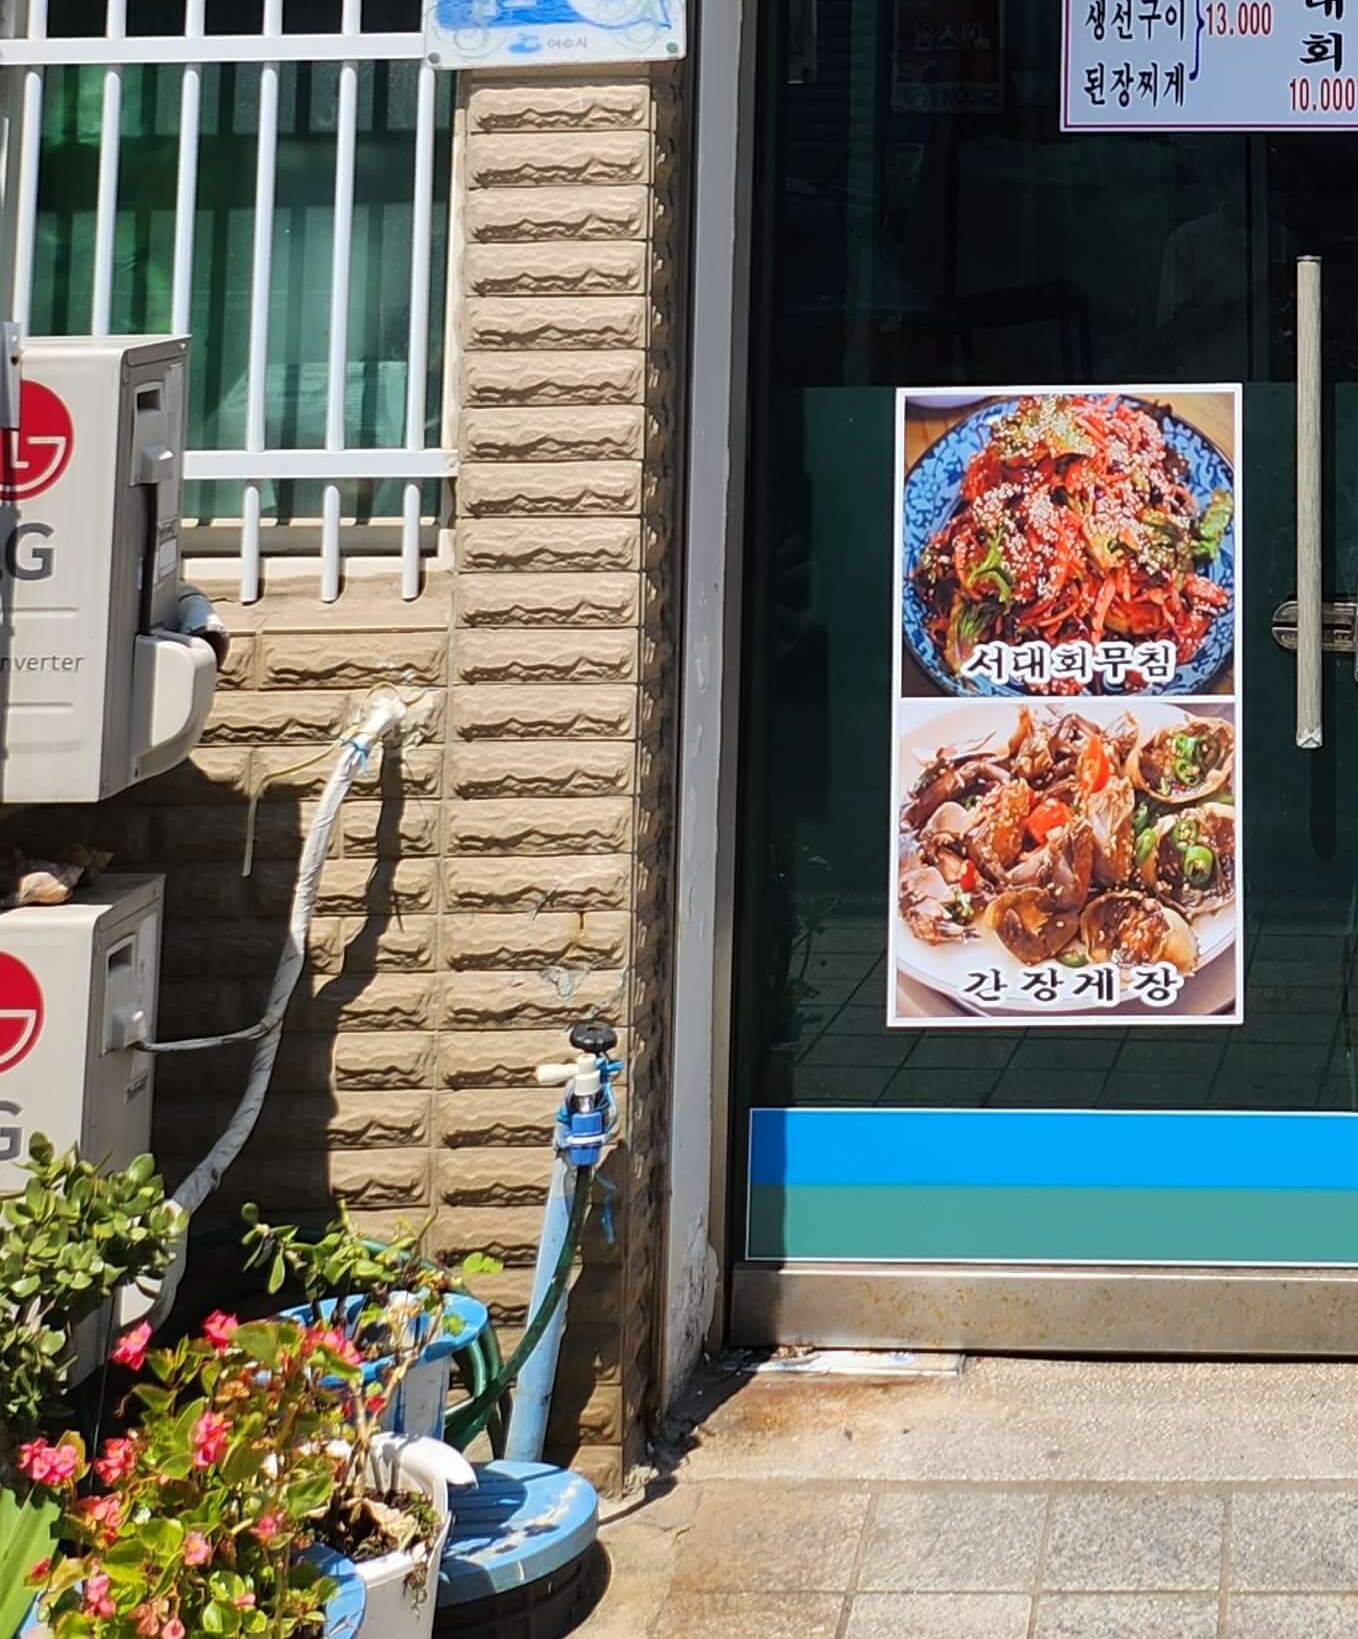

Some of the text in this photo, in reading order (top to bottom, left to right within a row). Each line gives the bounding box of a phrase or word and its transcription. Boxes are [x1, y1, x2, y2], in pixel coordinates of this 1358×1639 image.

[1205, 1, 1273, 36] 13.000
[1084, 62, 1187, 107] 된장찌게
[1288, 77, 1356, 112] 10.000
[0, 651, 84, 673] nverter
[965, 642, 1177, 681] 서대회무침
[965, 967, 1180, 1006] 간장게장
